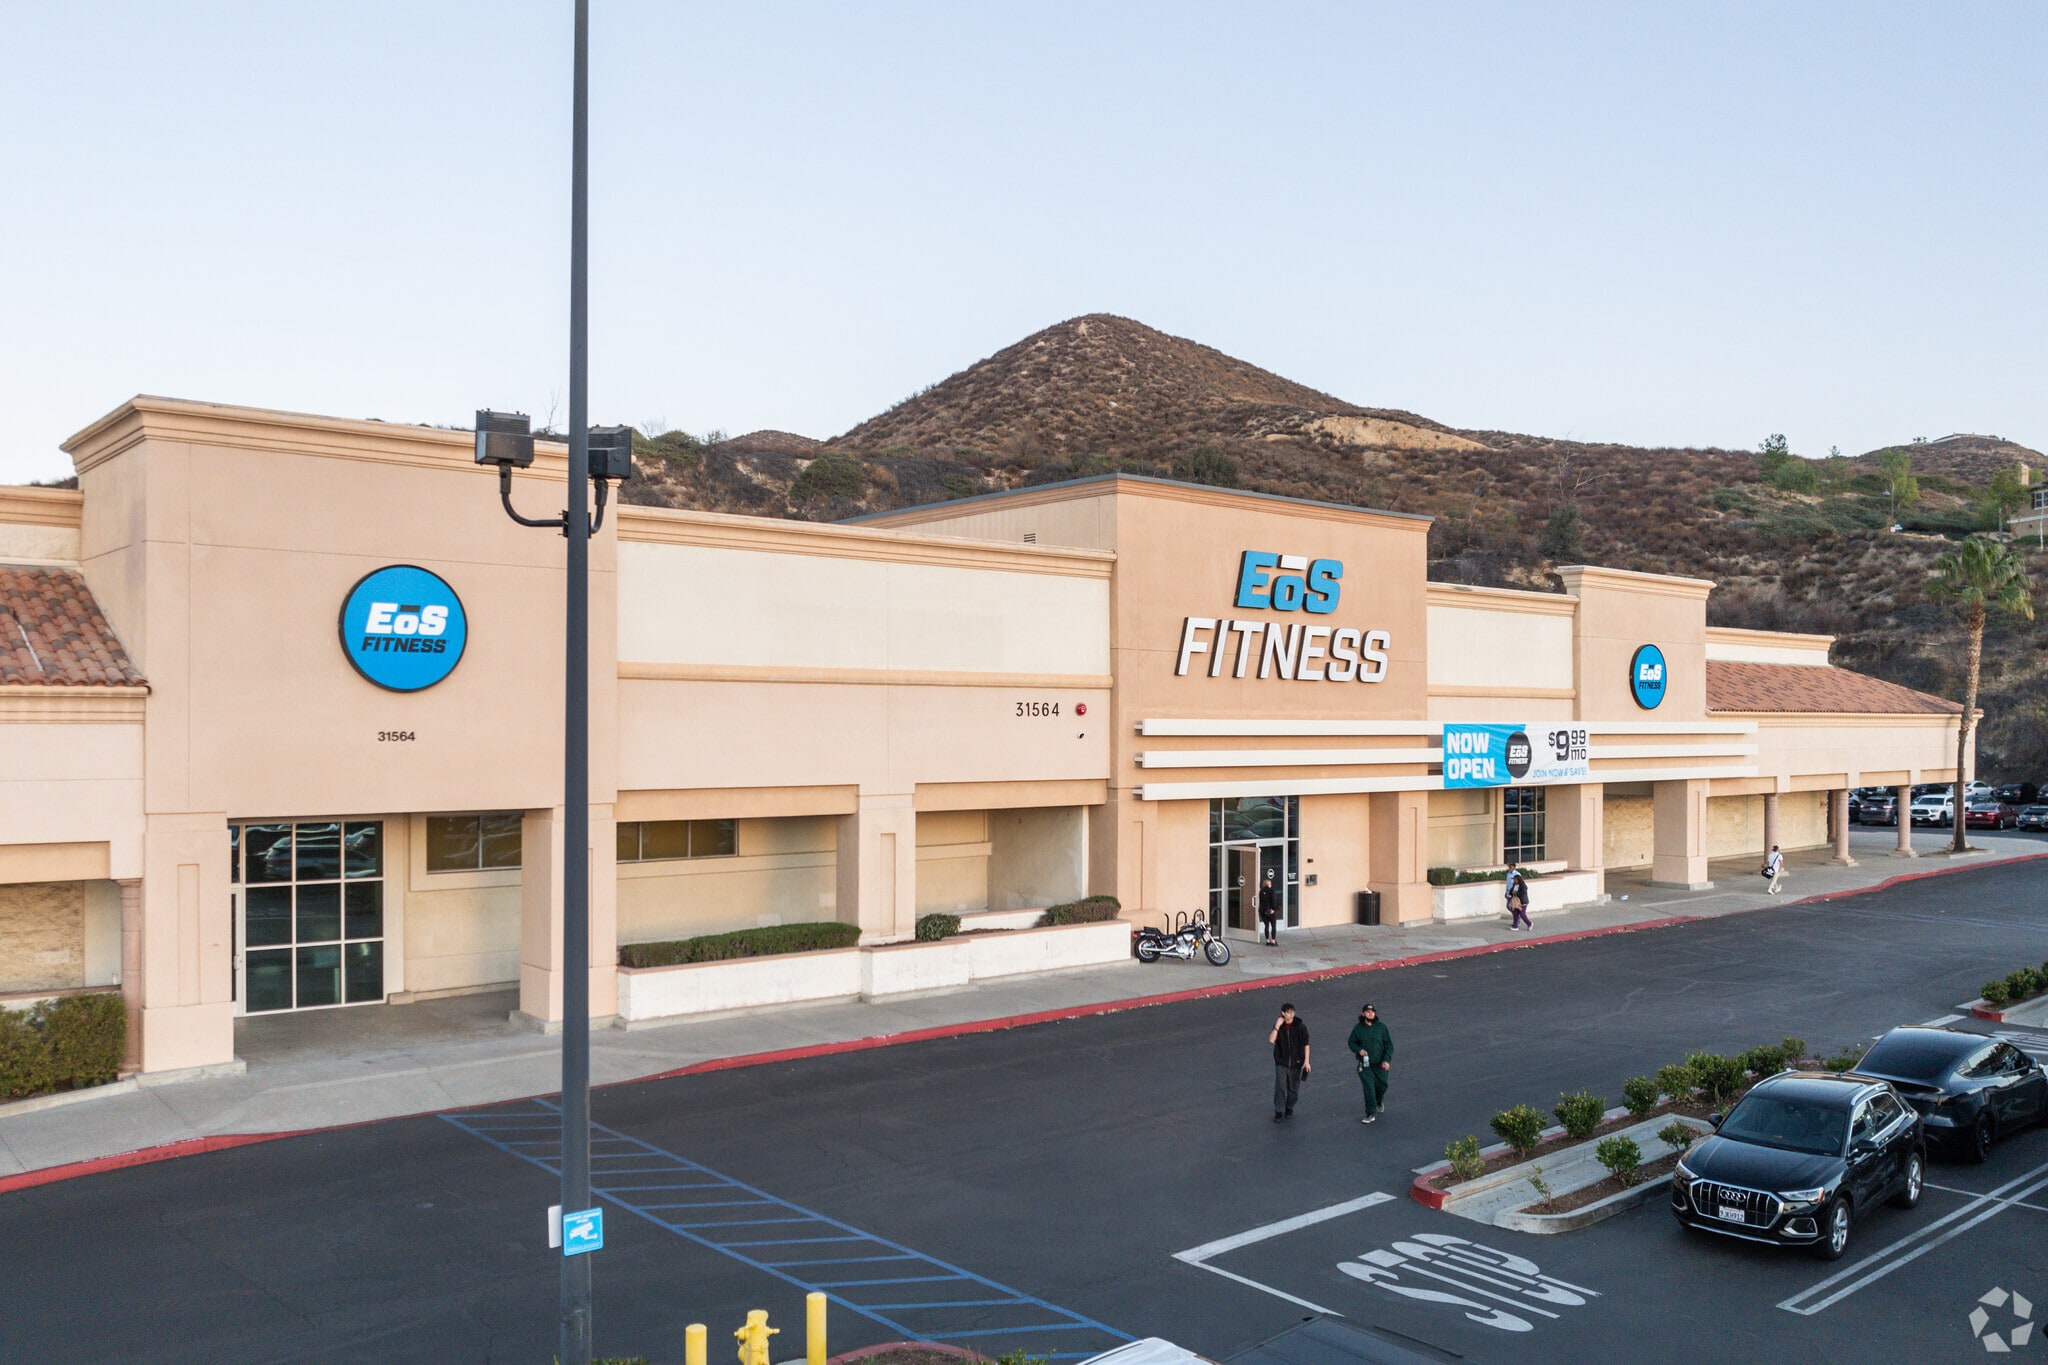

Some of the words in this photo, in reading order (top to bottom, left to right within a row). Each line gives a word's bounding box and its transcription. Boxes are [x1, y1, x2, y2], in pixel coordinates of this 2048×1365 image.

[361, 636, 447, 654] FITNESS
[1175, 616, 1391, 683] FITNESS
[1639, 682, 1661, 690] FITNESS
[1016, 702, 1060, 717] 31564
[377, 731, 416, 742] 31564
[1446, 732, 1490, 754] NOW
[1447, 757, 1495, 780] OPEN
[1532, 769, 1548, 779] JOIN
[1548, 768, 1563, 778] NOW
[1336, 1233, 1603, 1333] STOP
